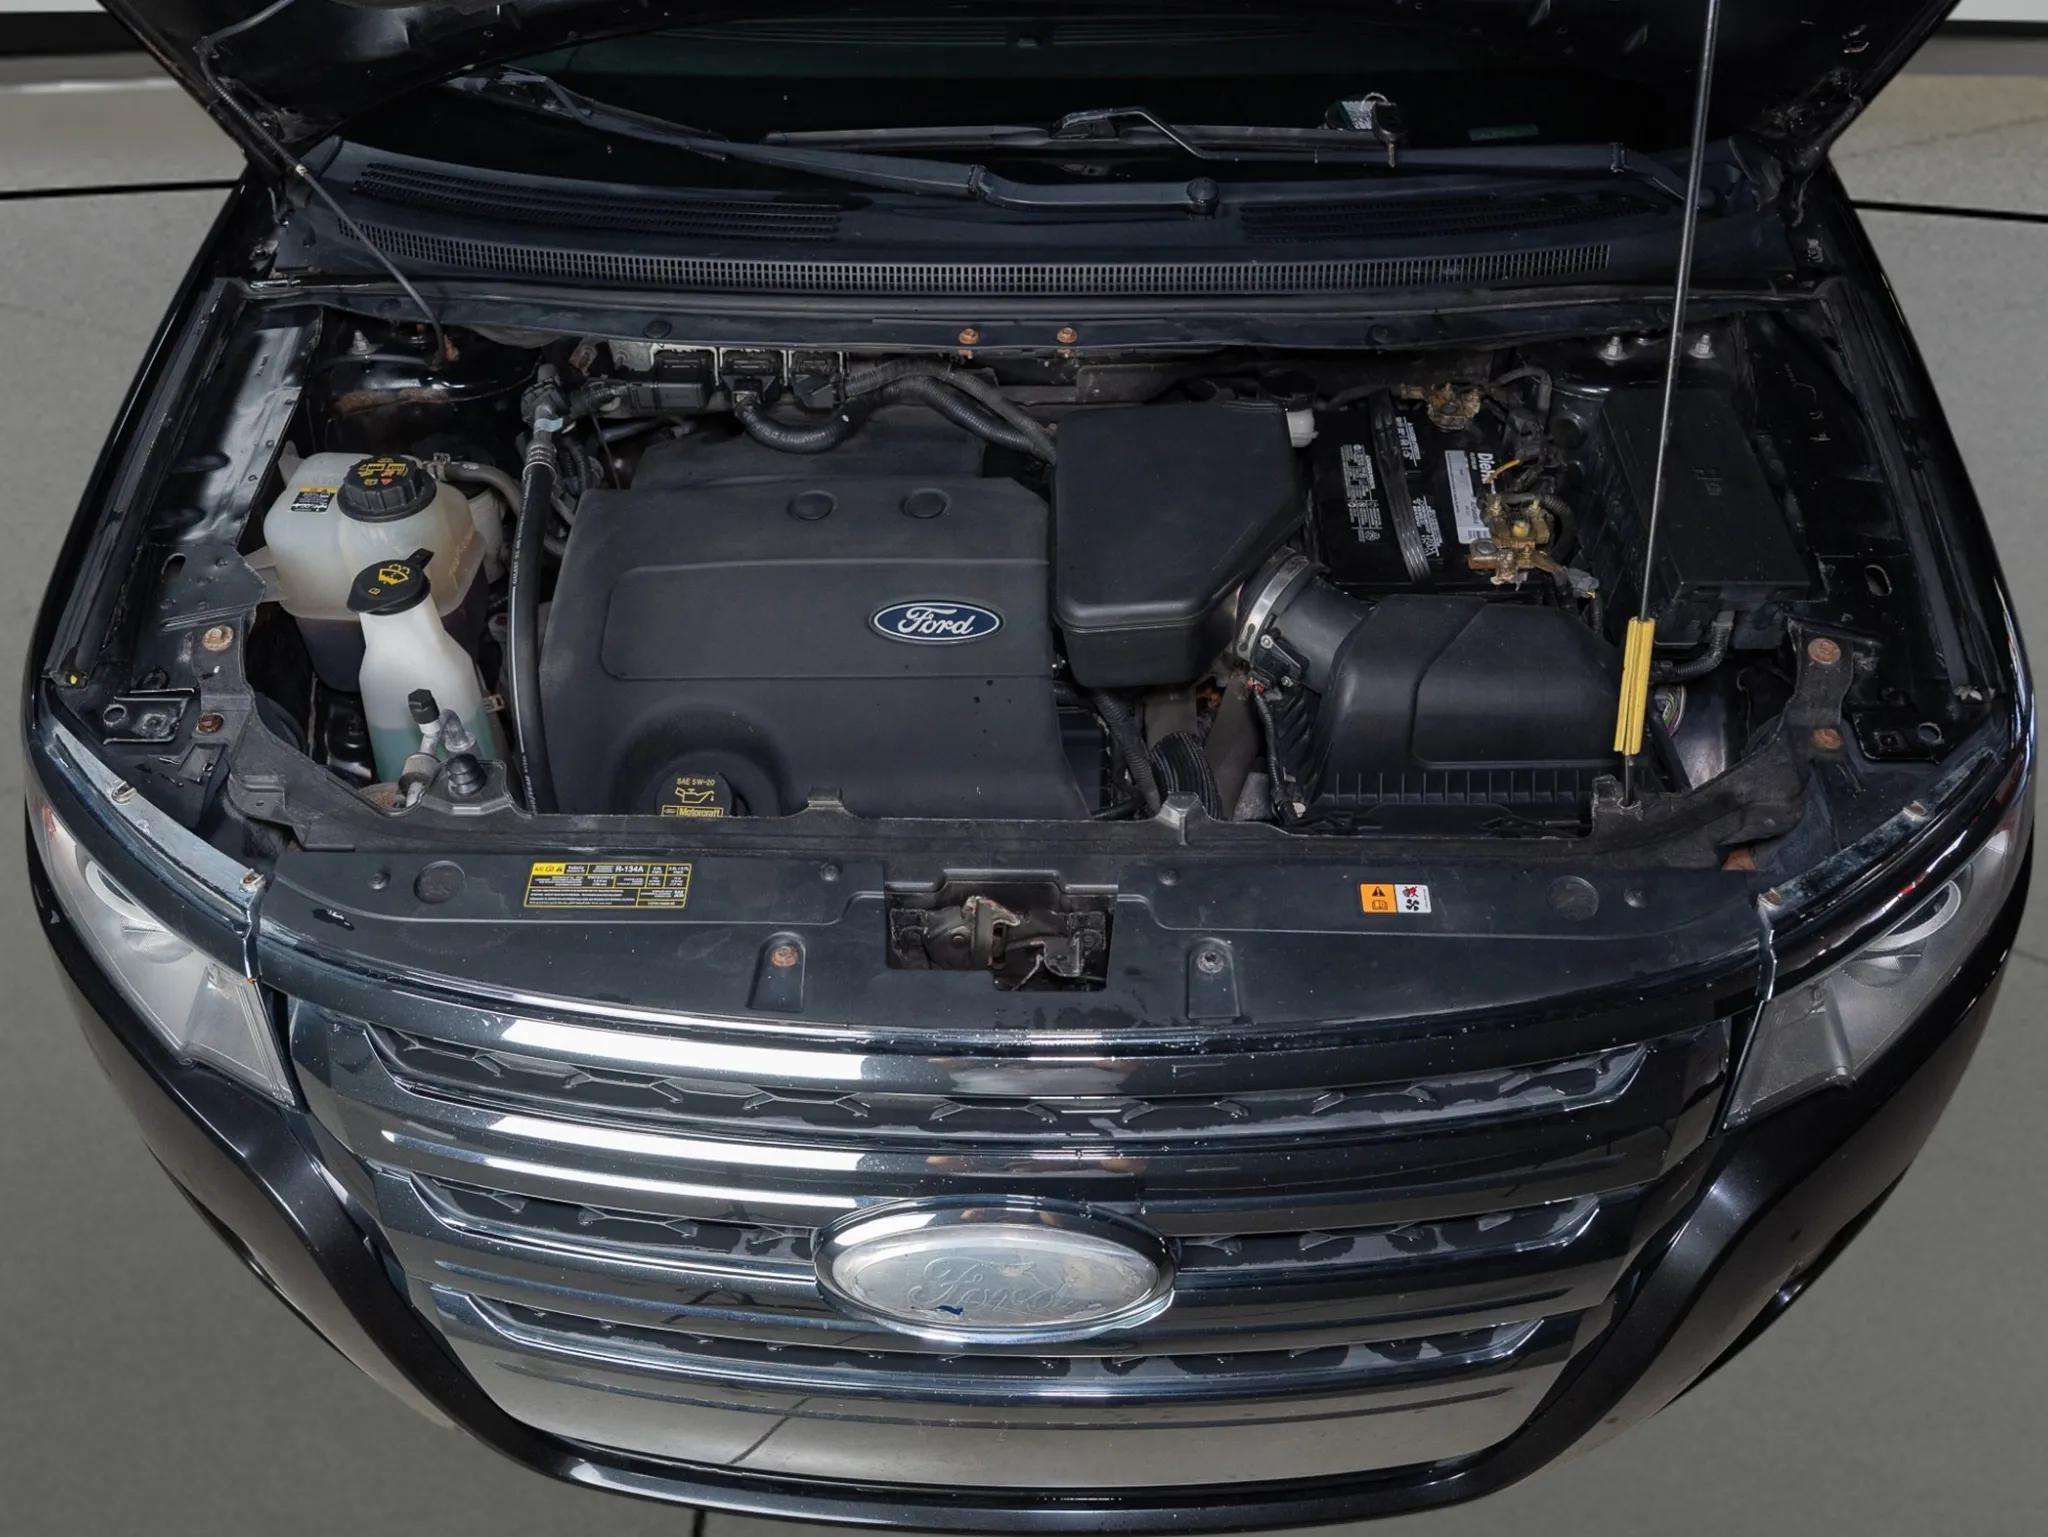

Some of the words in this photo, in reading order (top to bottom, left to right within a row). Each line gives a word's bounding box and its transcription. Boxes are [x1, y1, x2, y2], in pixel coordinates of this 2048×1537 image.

[897, 606, 976, 635] Ford
[691, 778, 716, 787] 5W-20
[678, 807, 721, 817] Motorcraft
[615, 865, 644, 873] R-134A
[908, 1256, 1076, 1314] Ford
